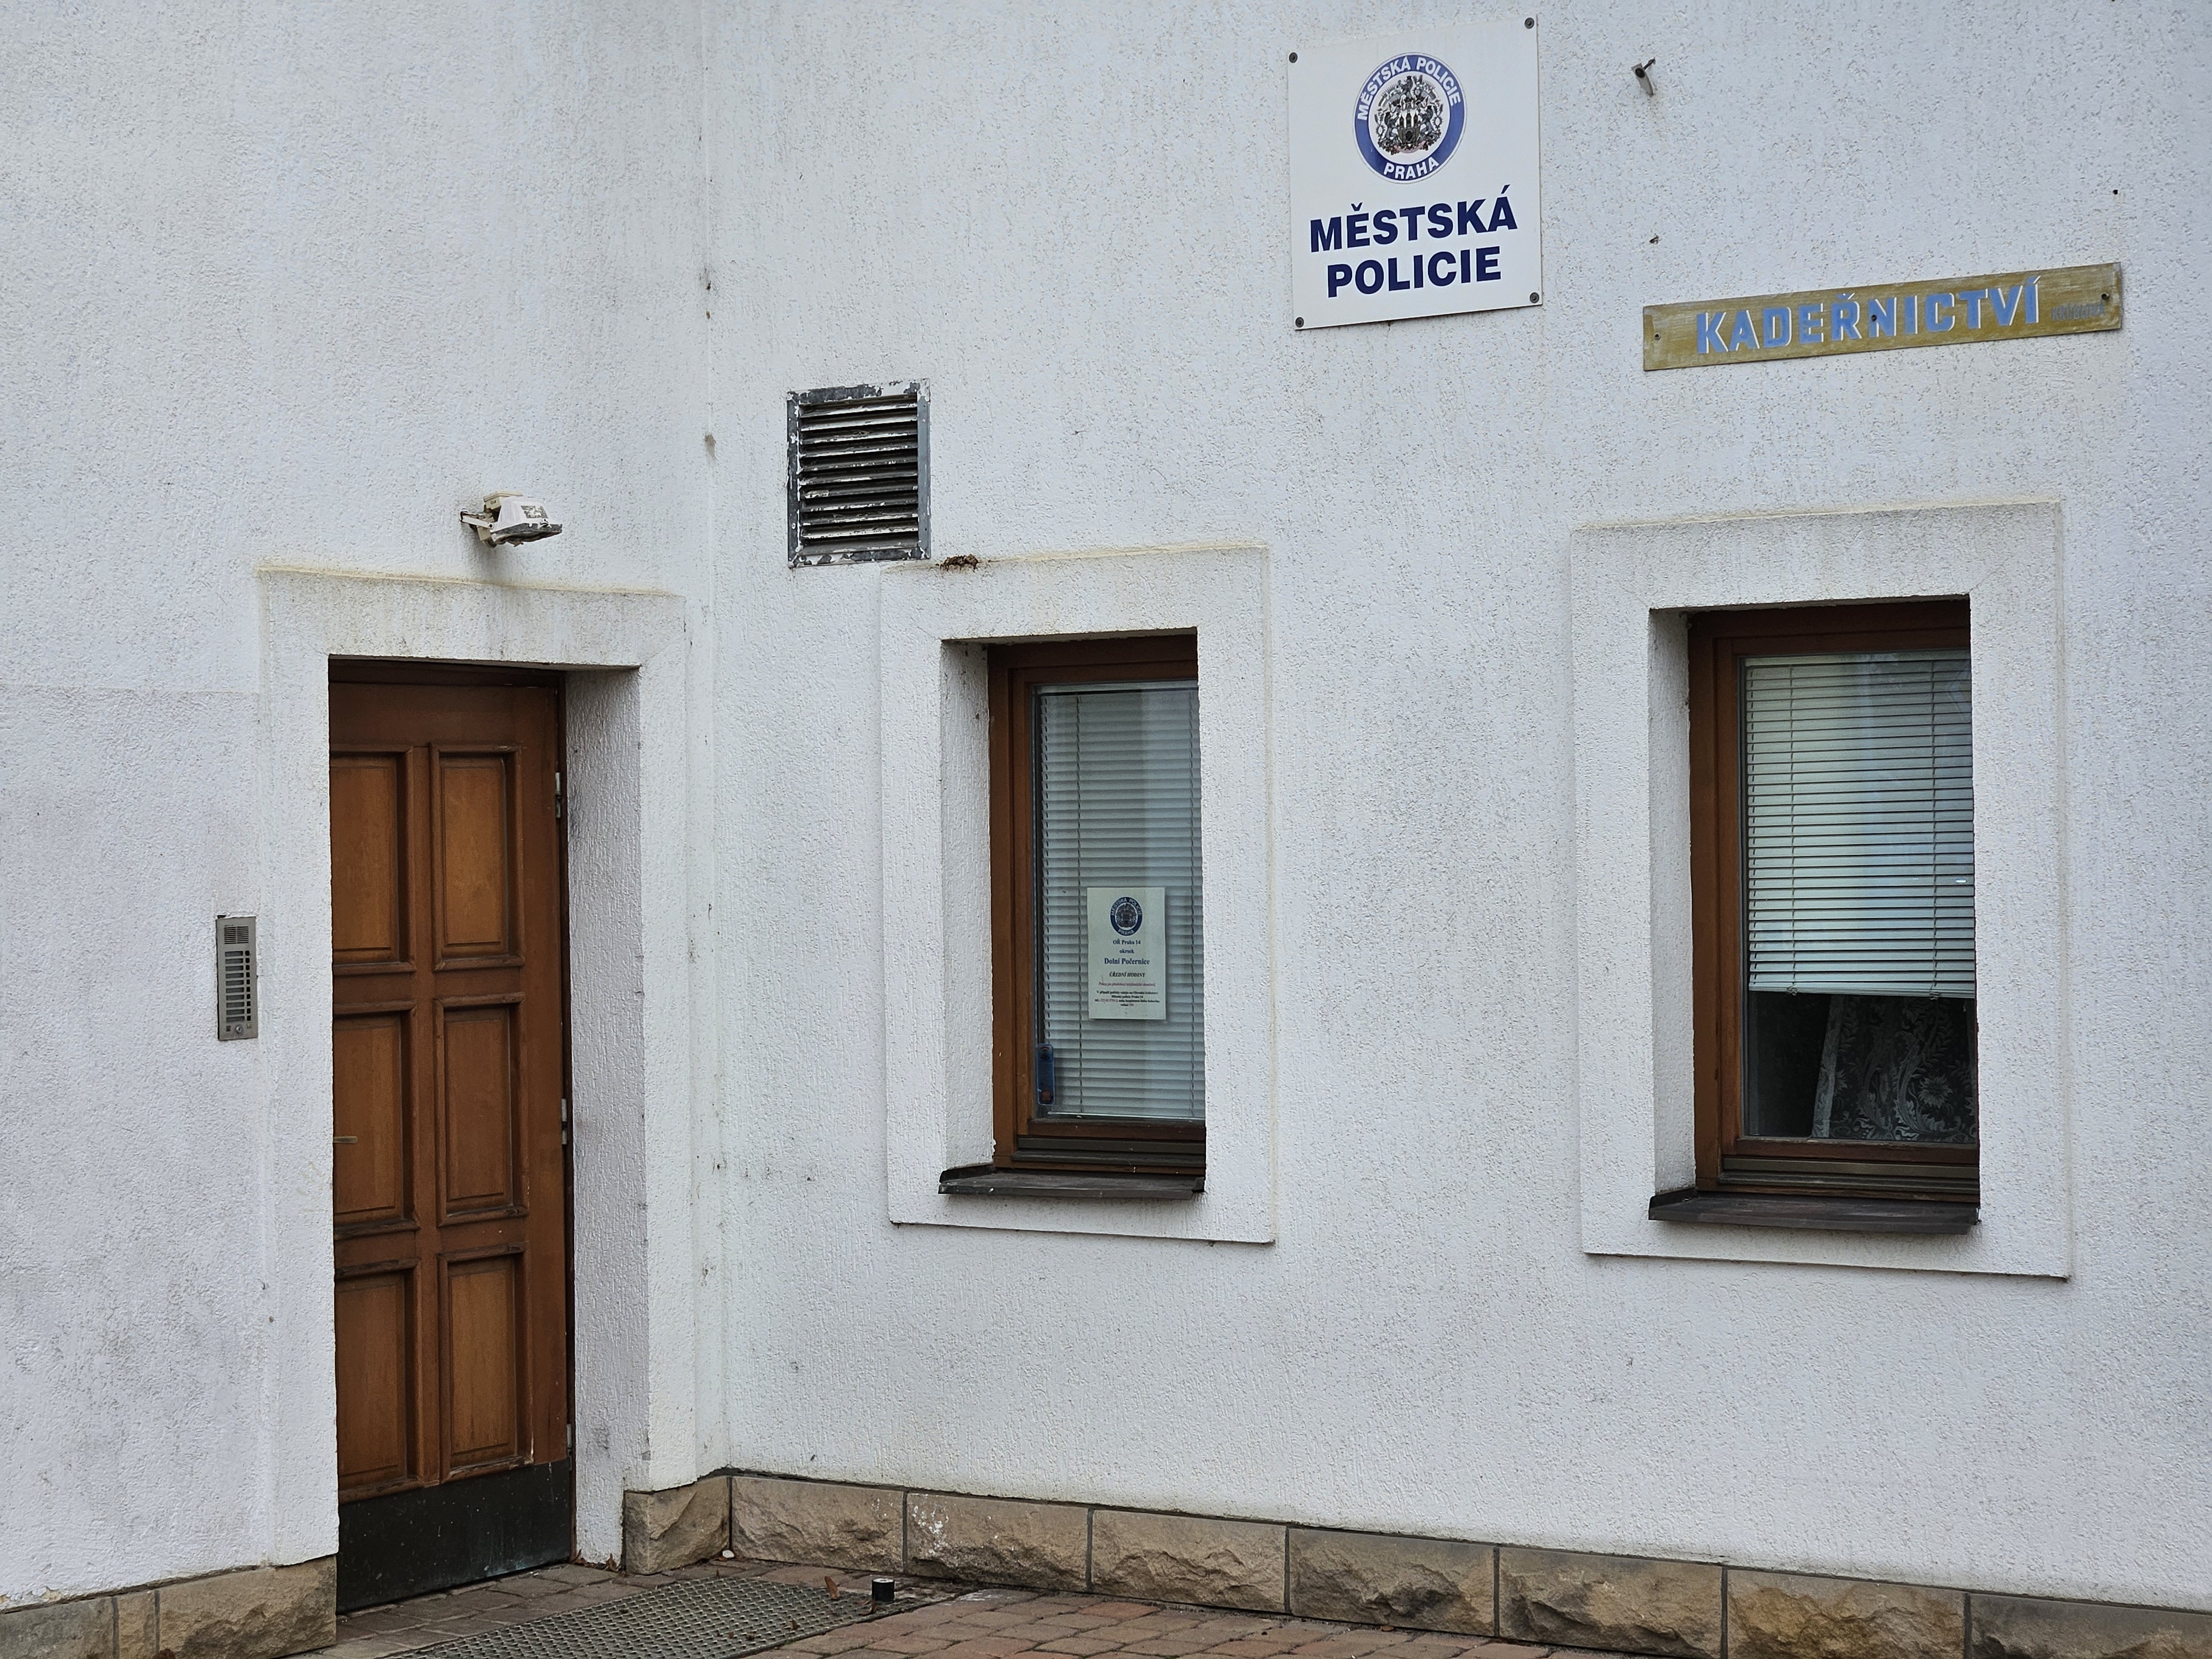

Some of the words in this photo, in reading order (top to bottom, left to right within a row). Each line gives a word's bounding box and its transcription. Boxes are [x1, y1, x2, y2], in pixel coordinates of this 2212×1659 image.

[1416, 57, 1461, 107] POLICIE
[1384, 156, 1439, 180] PRAHA
[1310, 184, 1518, 253] MĚSTSKÁ
[1327, 246, 1501, 298] POLICIE
[1696, 275, 2042, 354] KADEŘNICTVÍ
